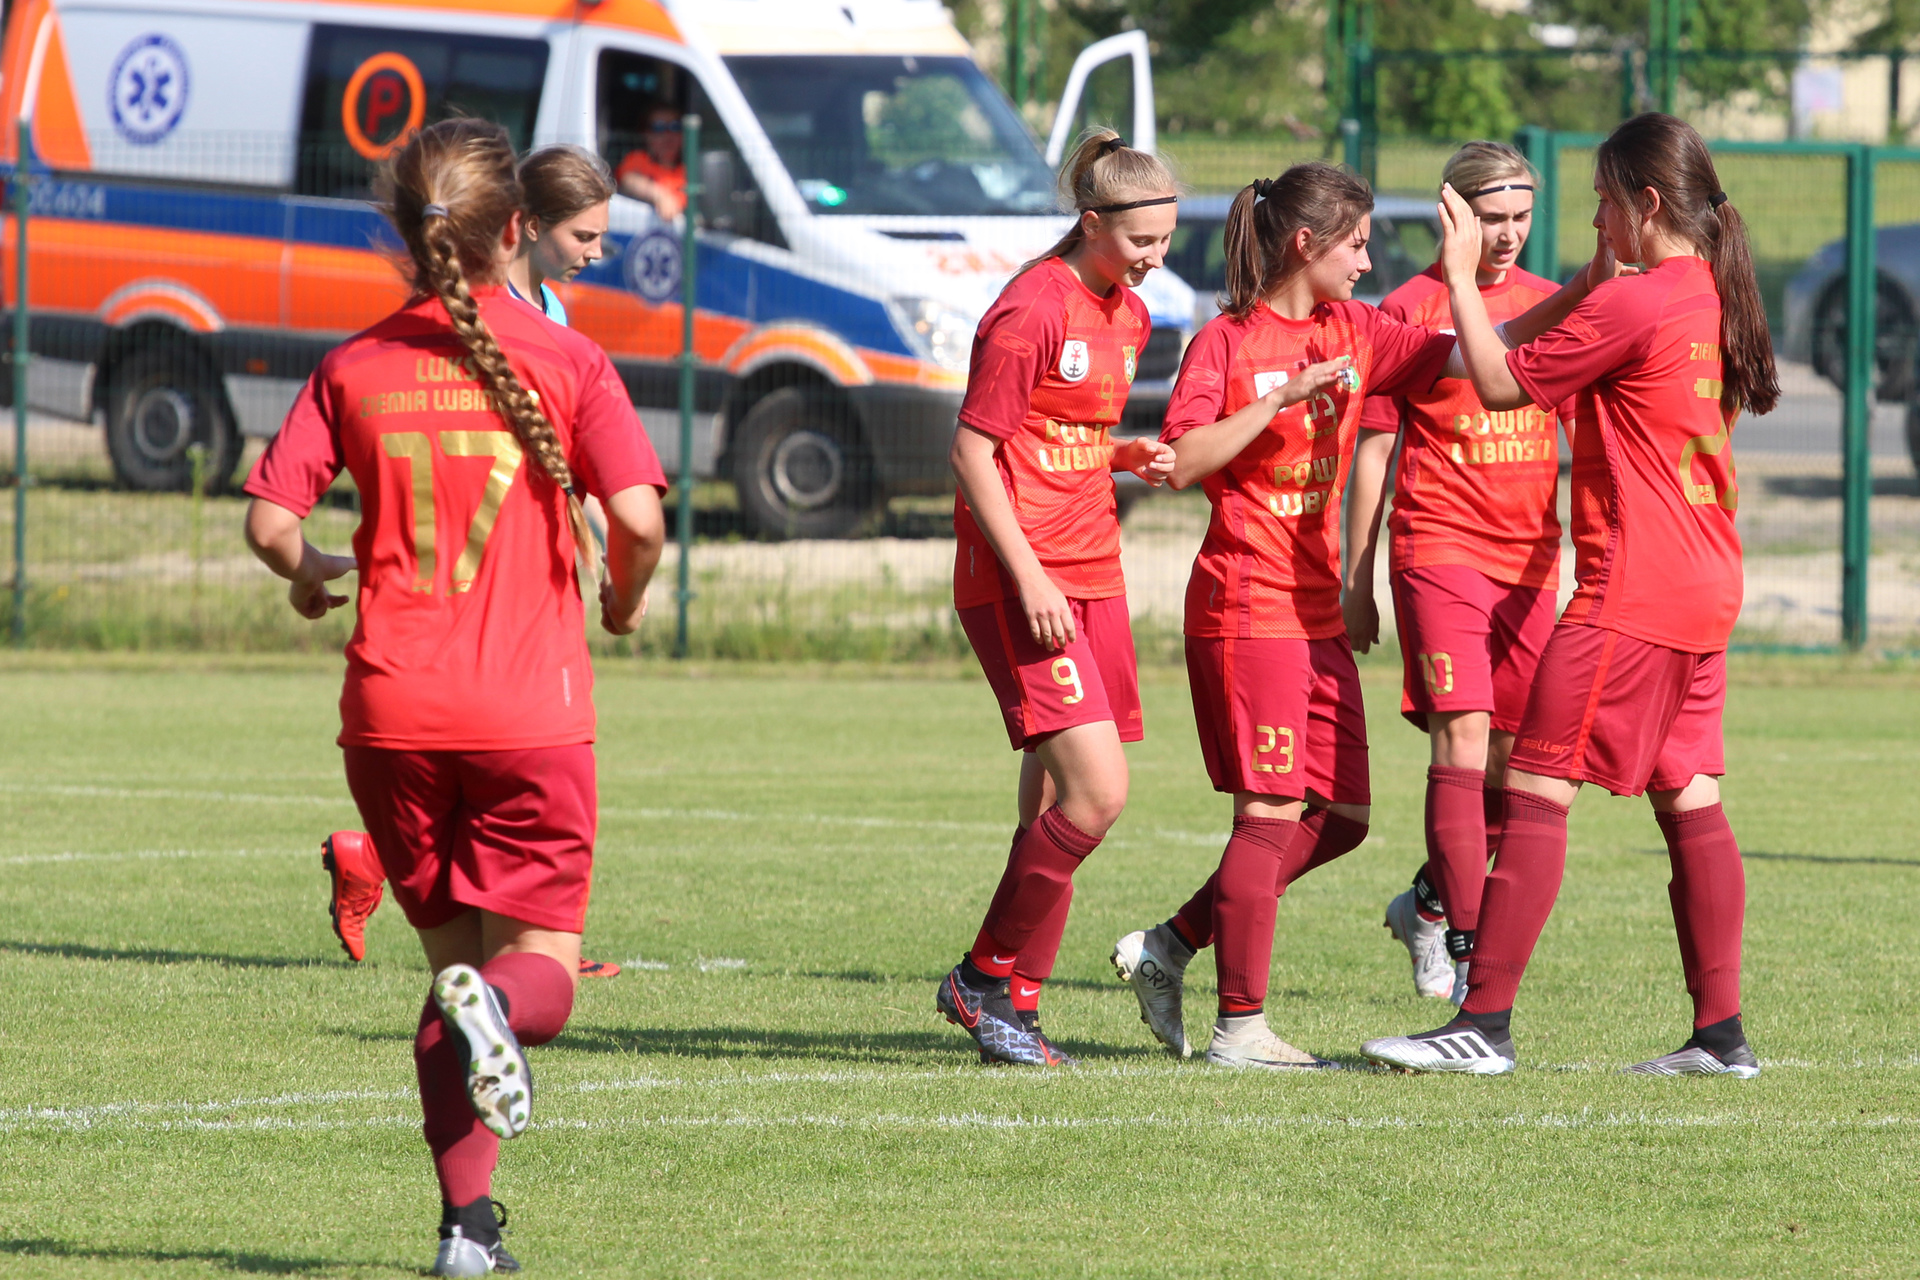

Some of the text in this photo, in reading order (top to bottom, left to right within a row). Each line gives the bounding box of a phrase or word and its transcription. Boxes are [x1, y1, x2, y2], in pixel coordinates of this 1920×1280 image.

[415, 356, 479, 382] LUKS
[360, 389, 427, 419] ZIEMIA
[1094, 373, 1115, 419] 9
[1454, 409, 1551, 436] POWIAT
[380, 430, 523, 596] 17
[1051, 657, 1084, 705] 9
[1418, 652, 1454, 696] 10
[1251, 724, 1295, 774] 23
[1140, 959, 1174, 990] CR7
